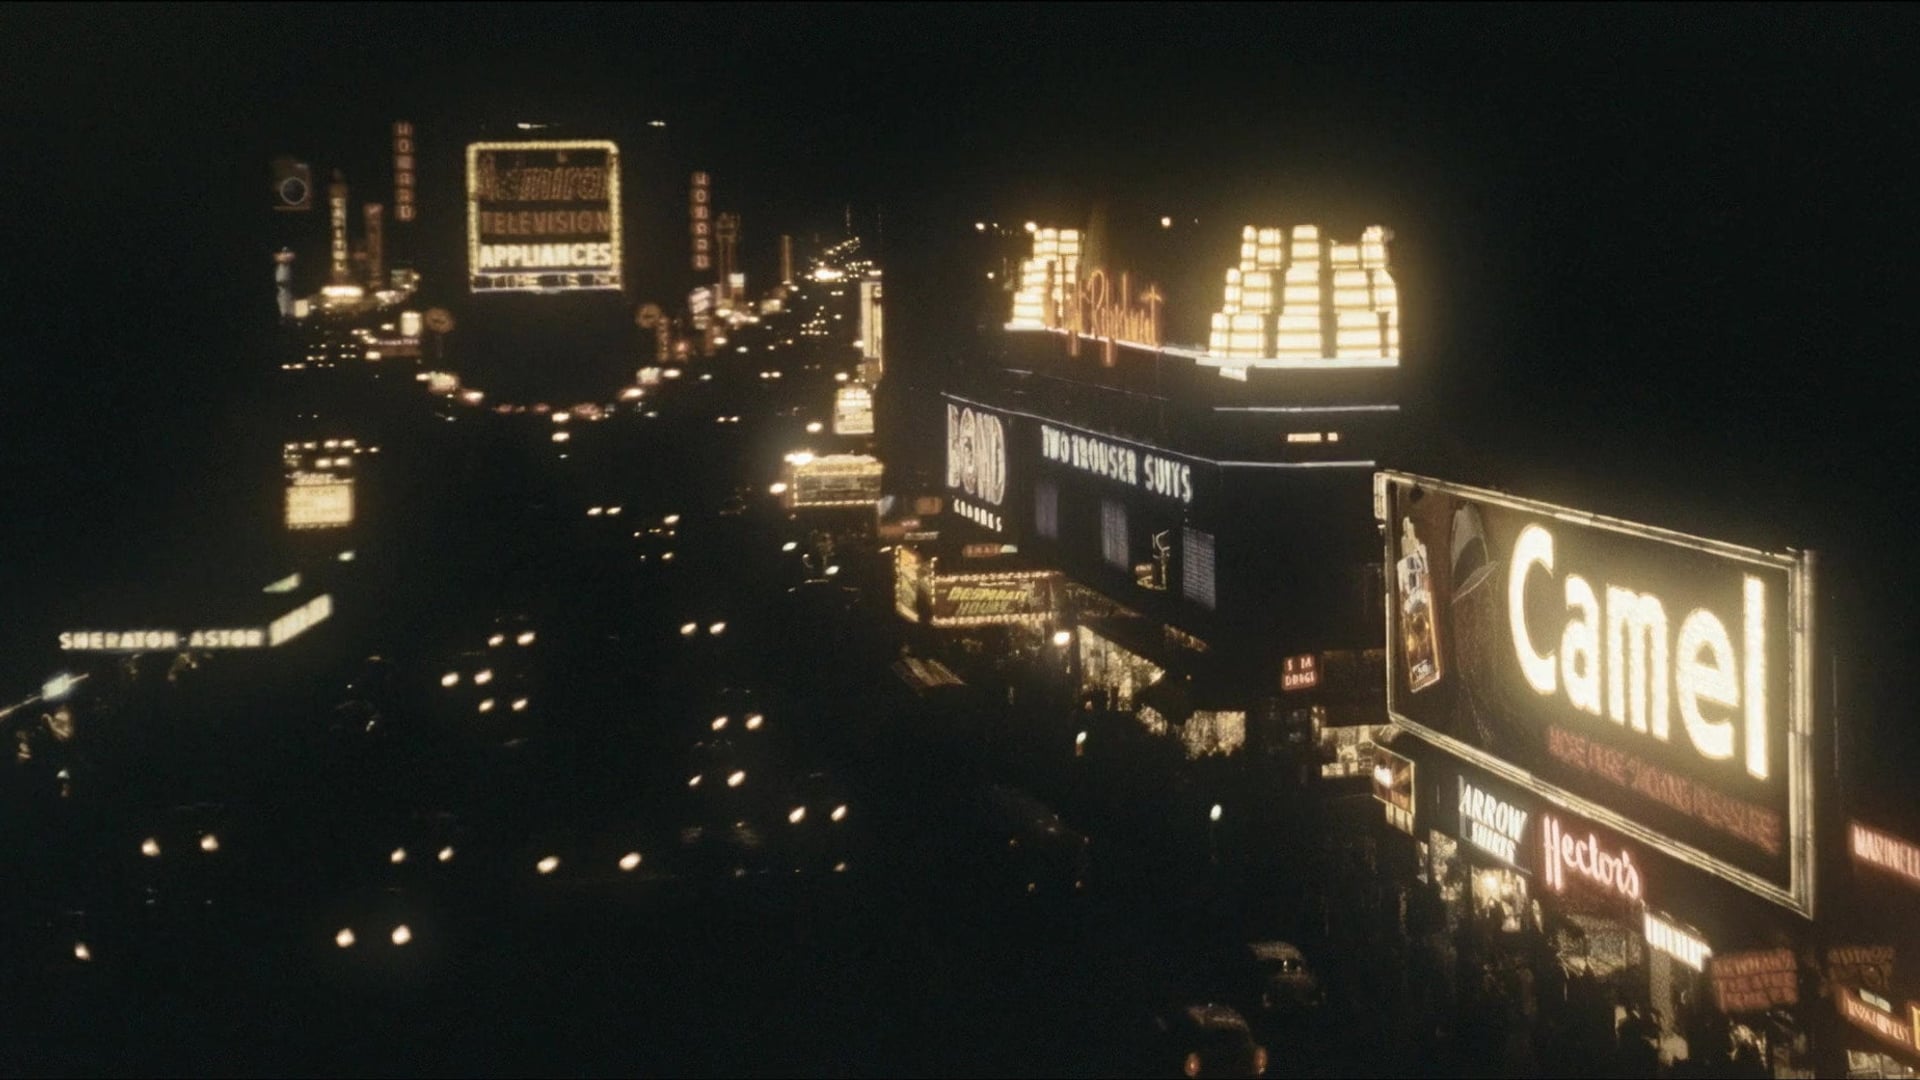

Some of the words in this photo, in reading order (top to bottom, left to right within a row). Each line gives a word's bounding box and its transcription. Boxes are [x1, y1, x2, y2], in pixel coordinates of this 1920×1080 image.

[479, 211, 610, 235] TELEVISION
[479, 242, 612, 268] APPLIANCES
[947, 403, 1006, 506] BOND
[1041, 424, 1070, 464] TWO
[1071, 434, 1138, 486] TROUSER
[1144, 454, 1193, 503] SUITS
[58, 630, 178, 650] SHERATON
[189, 629, 264, 648] ASTOR
[1508, 522, 1770, 781] Camel
[1459, 783, 1528, 844] ARROW
[1543, 814, 1641, 900] Hector's
